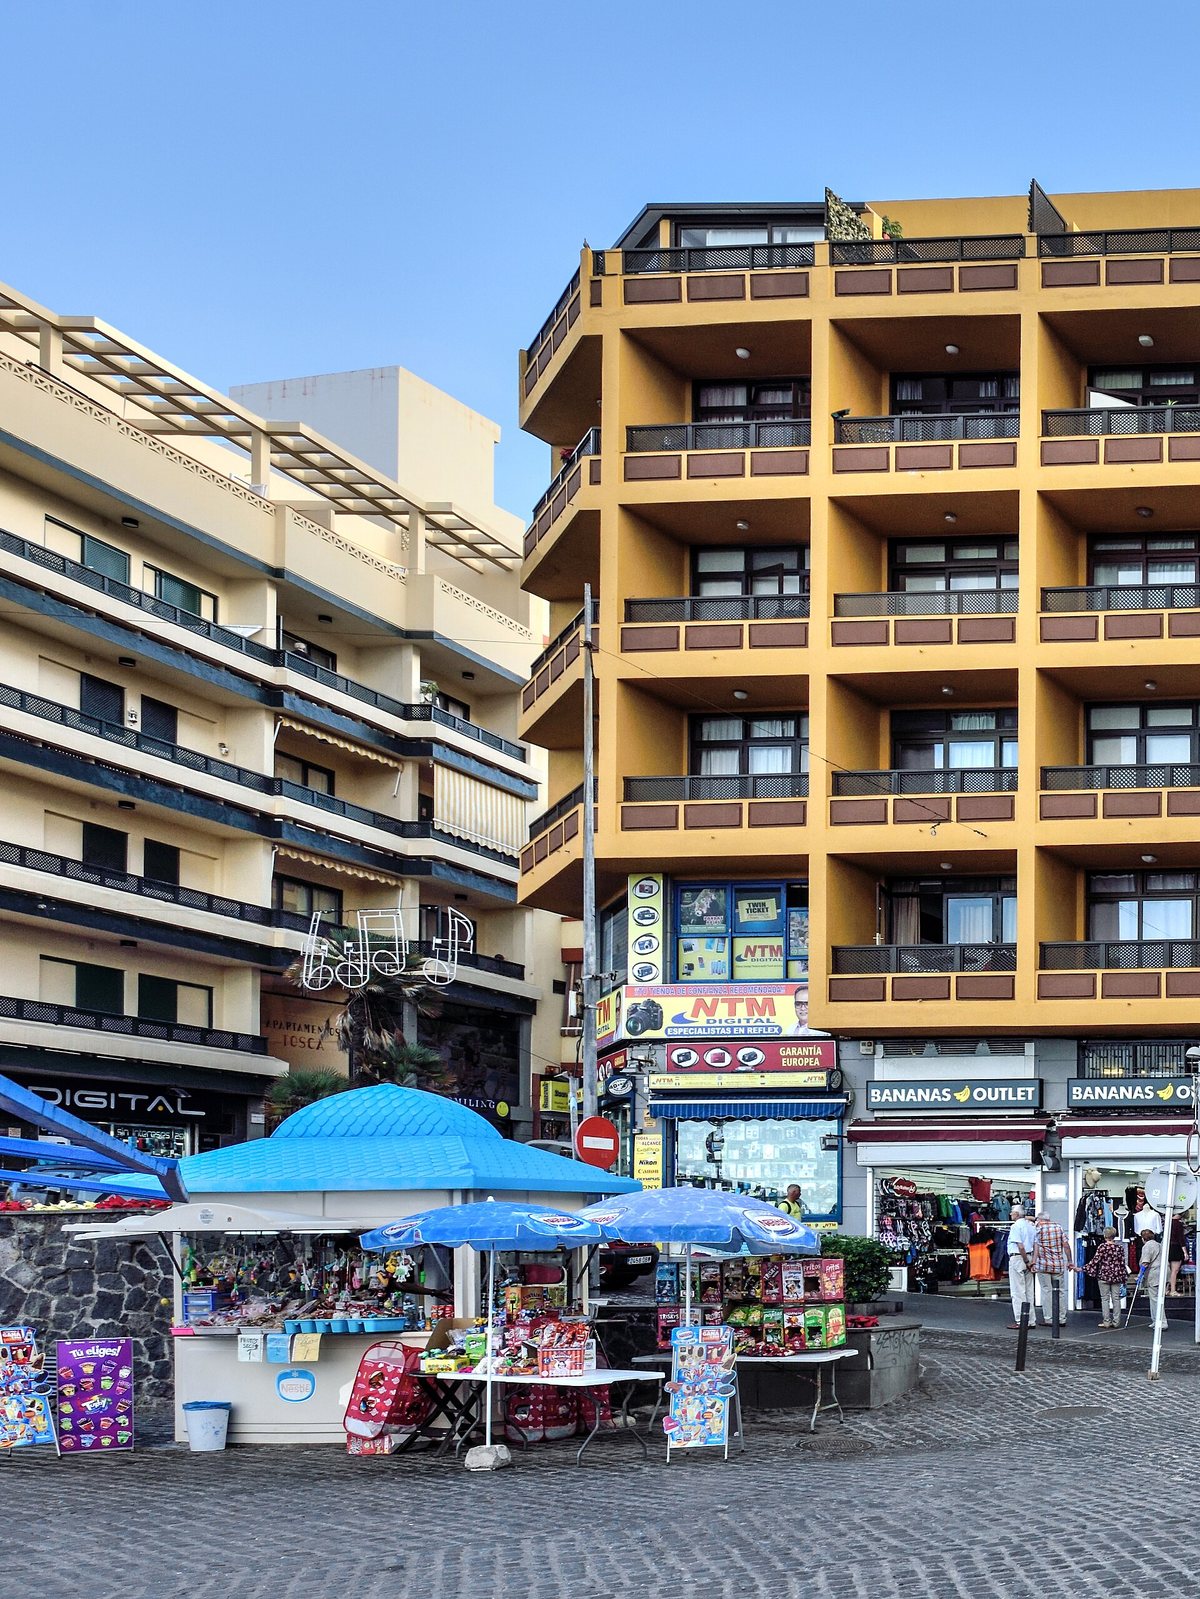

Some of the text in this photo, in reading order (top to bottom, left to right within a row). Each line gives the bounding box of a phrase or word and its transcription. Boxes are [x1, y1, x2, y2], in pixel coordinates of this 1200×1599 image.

[744, 944, 783, 958] NTM
[650, 986, 676, 996] TIENDA
[676, 987, 686, 995] DE
[688, 986, 728, 995] CONFIANZA
[596, 998, 610, 1026] TM
[690, 998, 776, 1018] NTM
[265, 1019, 341, 1036] APARTAMENOS
[667, 1026, 780, 1036] ESPECIALISTAS EN REFLEX
[283, 1034, 325, 1051] TOSCA
[780, 1045, 822, 1056] GARANTÍA
[782, 1058, 820, 1067] EUROPEA
[871, 1087, 1035, 1102] BANANAS OUTLET
[1072, 1086, 1154, 1100] BANANAS
[28, 1086, 206, 1116] DIGITAL
[116, 1128, 130, 1136] sin
[132, 1129, 170, 1140] intereses
[804, 1263, 820, 1272] Fritos
[826, 1263, 840, 1273] Fritos
[69, 1345, 122, 1358] Tú eliges!
